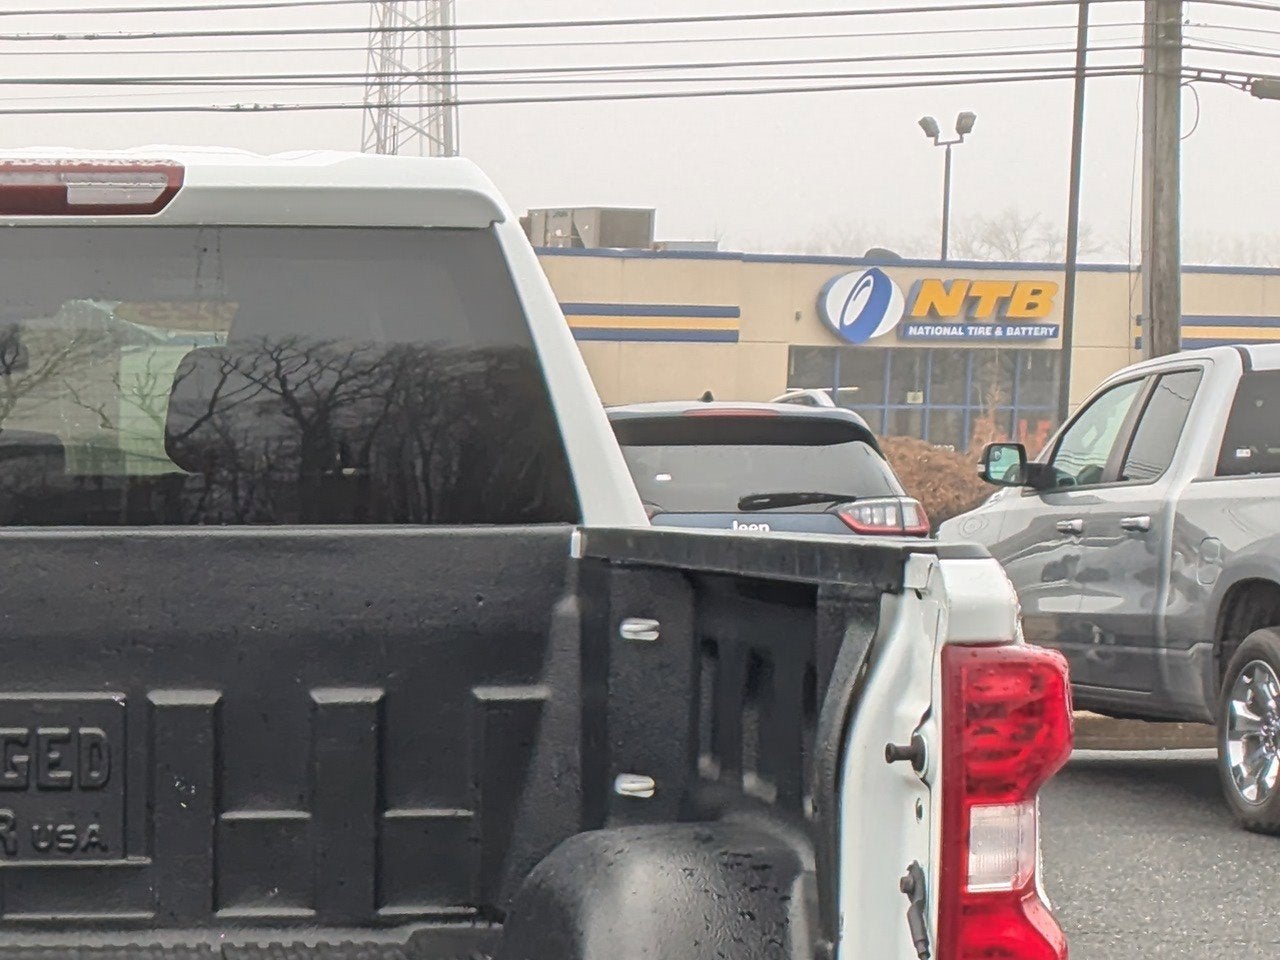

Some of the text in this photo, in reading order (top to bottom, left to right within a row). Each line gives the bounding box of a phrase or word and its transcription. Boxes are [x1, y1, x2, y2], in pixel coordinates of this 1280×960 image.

[911, 278, 1059, 318] NTB
[908, 326, 1056, 336] NATIONAL TIRE & BATTERY
[31, 823, 109, 853] USA
